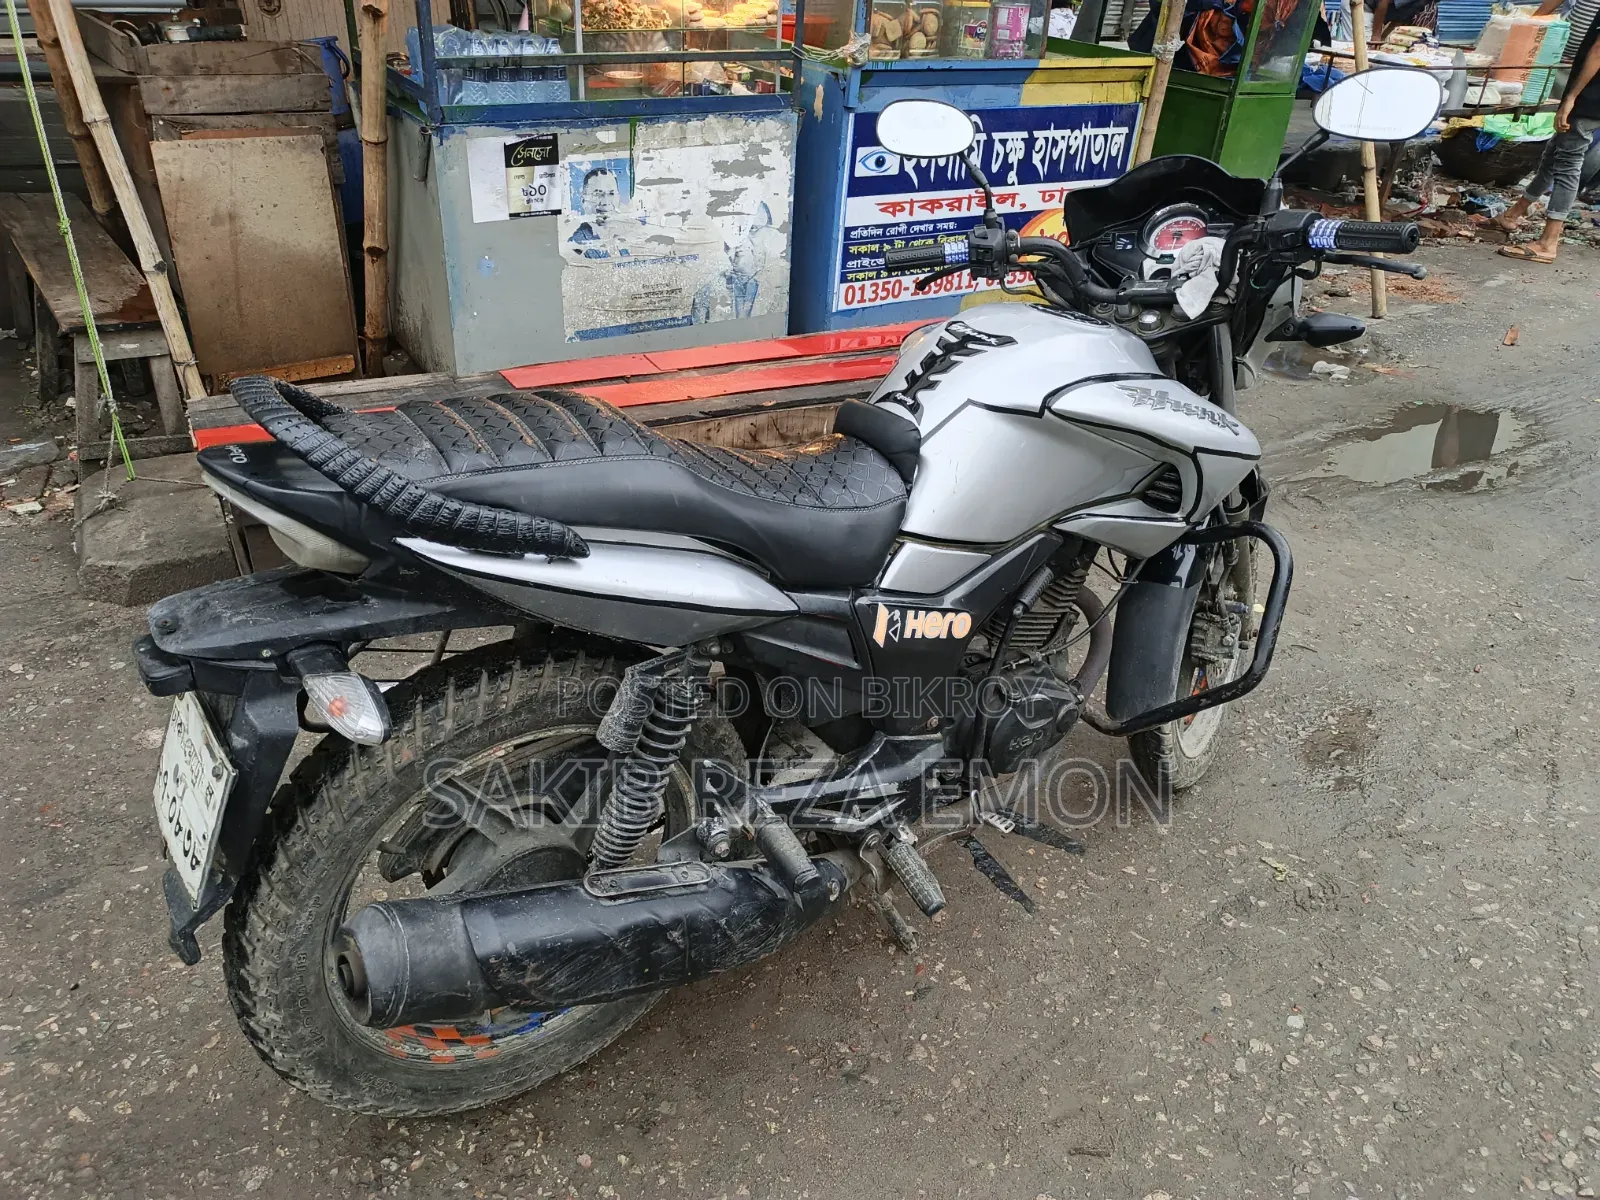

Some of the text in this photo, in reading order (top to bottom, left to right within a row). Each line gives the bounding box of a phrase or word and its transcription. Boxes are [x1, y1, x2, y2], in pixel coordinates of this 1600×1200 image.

[991, 131, 1029, 186] চক্ষু
[1032, 120, 1129, 181] হাসপাতাল
[874, 189, 1027, 218] কাকরাইল,
[849, 226, 883, 239] প্রতিদিন
[885, 223, 908, 236] রোগী
[909, 223, 934, 234] দেখার
[848, 244, 880, 255] সকাল
[846, 257, 886, 268] প্রাইভে
[846, 271, 877, 281] সকাল
[903, 609, 972, 639] Hero
